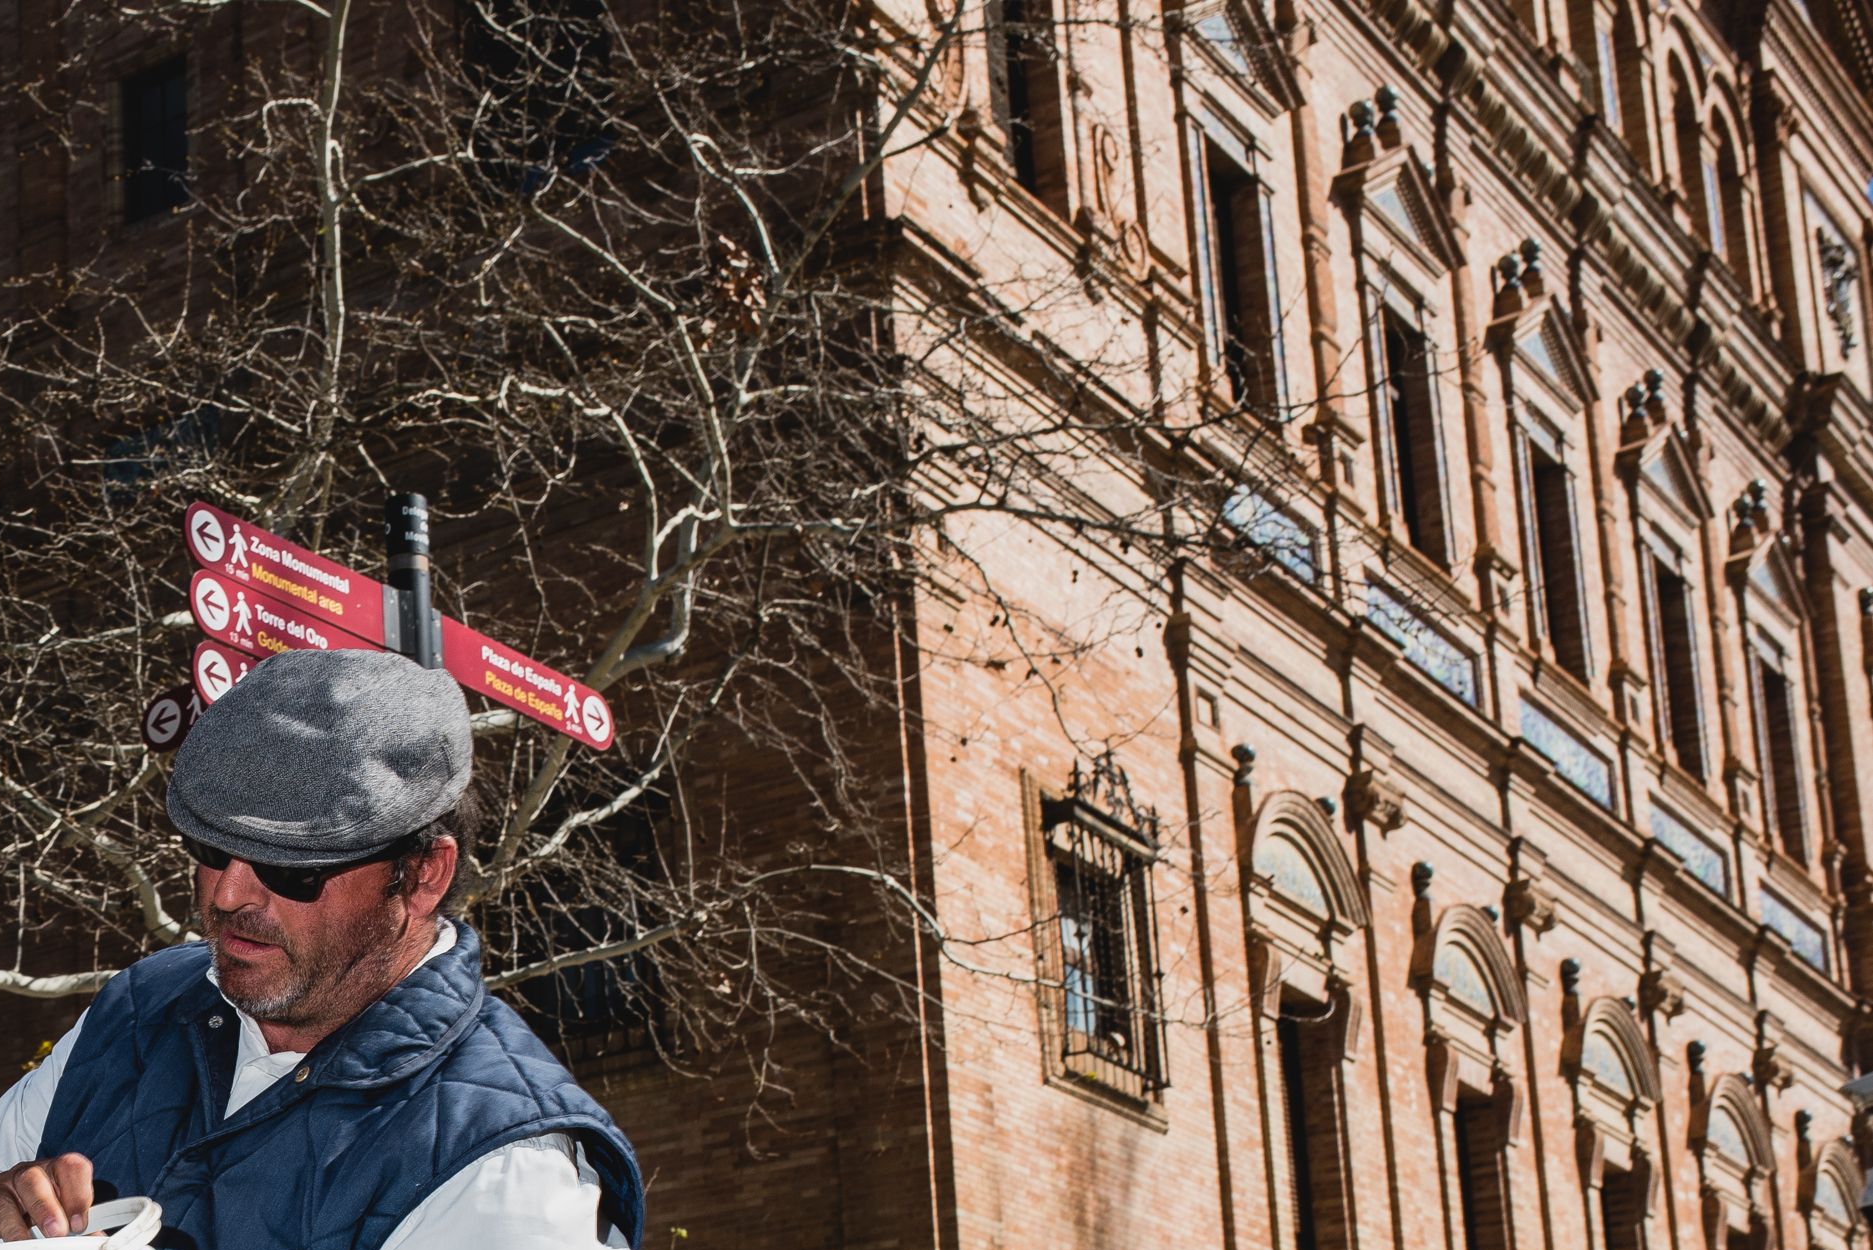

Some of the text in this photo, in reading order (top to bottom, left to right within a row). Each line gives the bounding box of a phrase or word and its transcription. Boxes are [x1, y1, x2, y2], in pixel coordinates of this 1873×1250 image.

[250, 536, 350, 594] Zona Monumental
[251, 562, 344, 616] Monumental area
[254, 604, 328, 650] Torre del Oro
[481, 645, 562, 696] Plaza de España
[485, 671, 563, 721] Plaza de España
